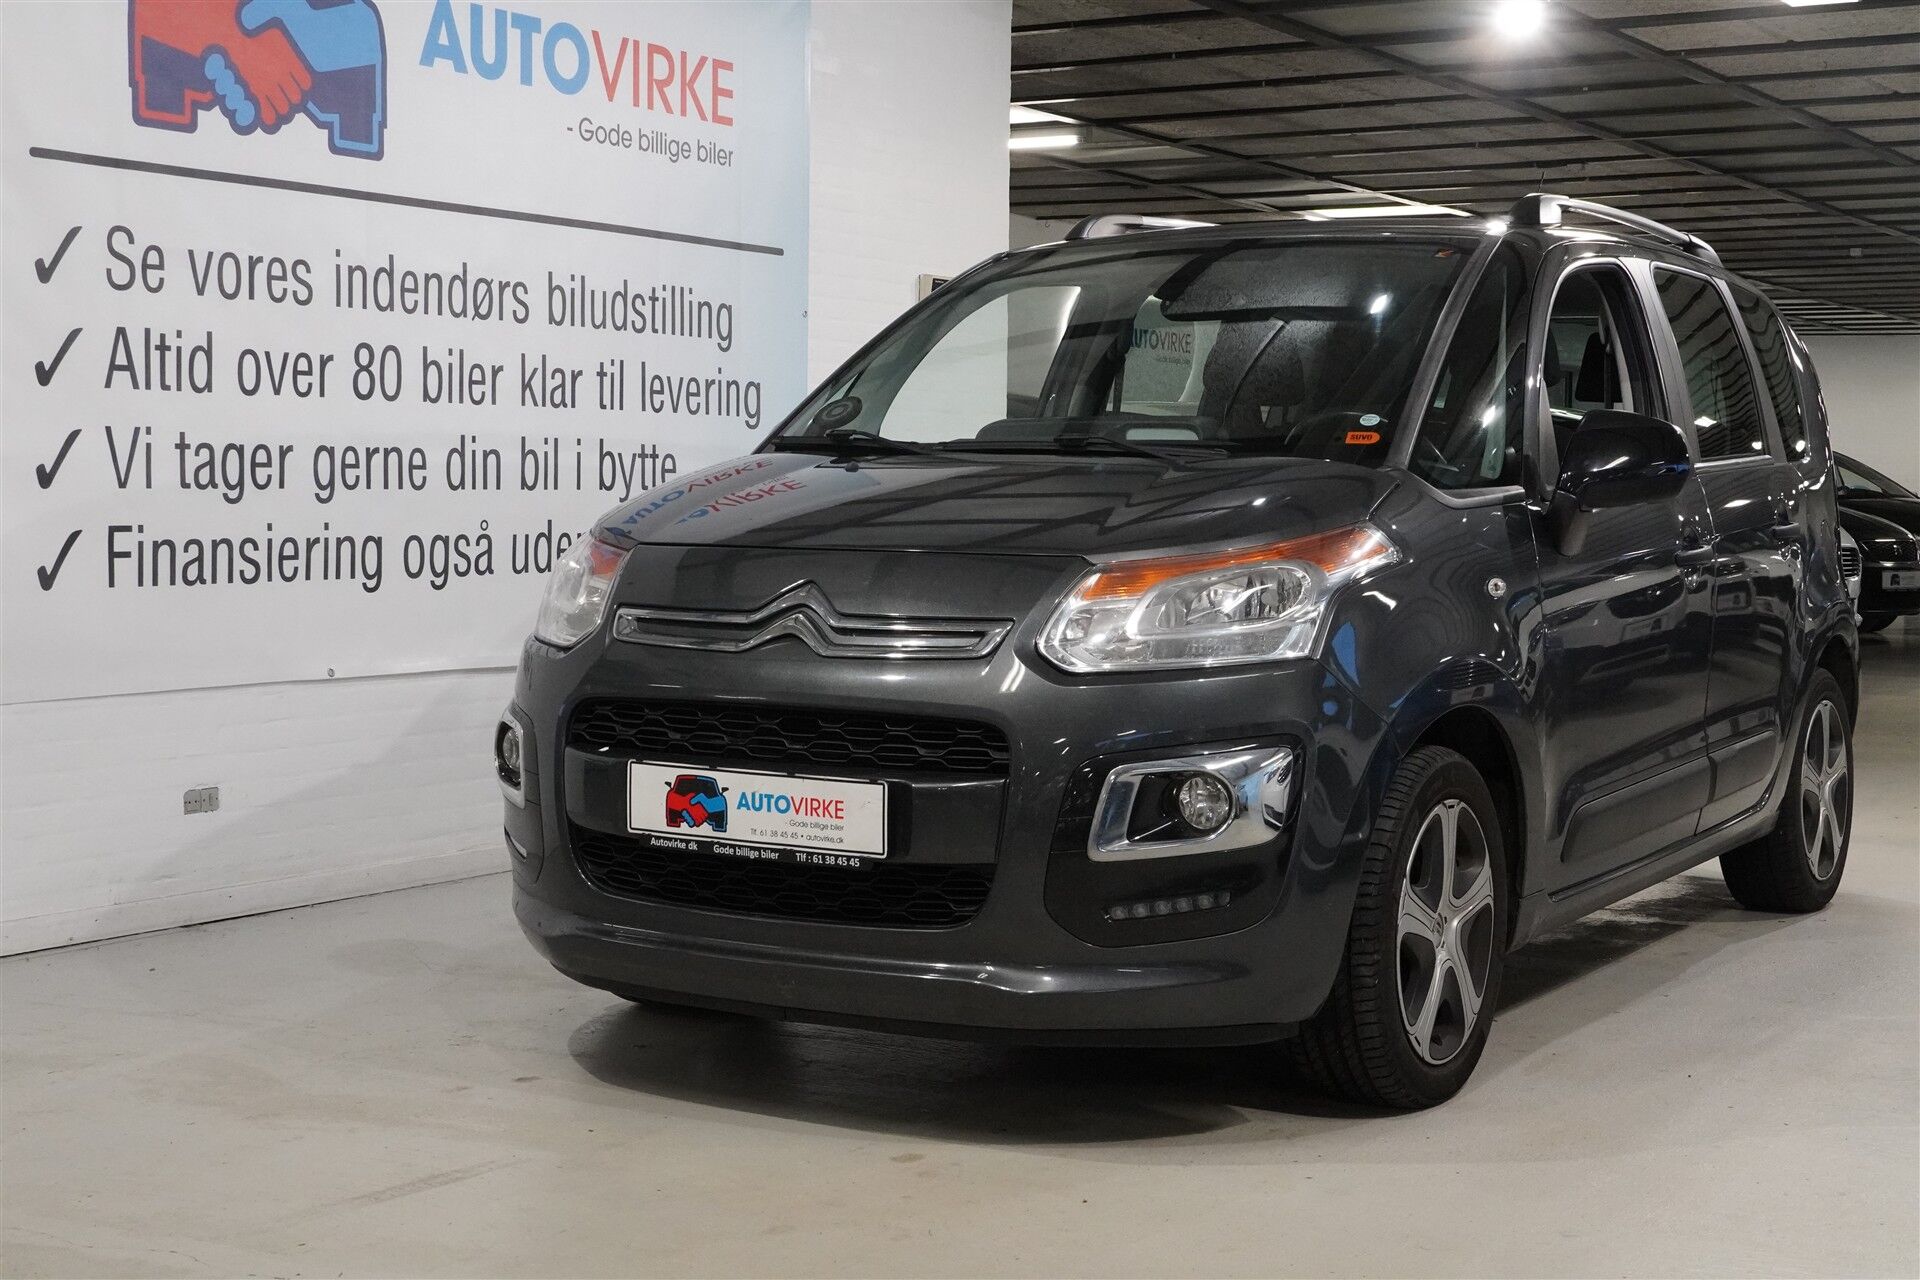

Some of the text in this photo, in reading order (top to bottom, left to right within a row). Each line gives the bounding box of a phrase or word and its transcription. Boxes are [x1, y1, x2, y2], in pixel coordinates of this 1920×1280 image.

[419, 0, 734, 127] AUTOVIRKE
[578, 117, 633, 149] Gode
[638, 128, 692, 164] billige
[697, 139, 734, 167] biler
[106, 225, 733, 353] Se vores indendørs biludstilling
[1130, 328, 1191, 354] UTOVIRKE
[104, 326, 761, 430] Altid over 80 biler klar til levering
[104, 425, 677, 505] Vi tager gerne din bil i bytte
[107, 519, 582, 594] Finansiering også ude
[736, 791, 844, 819] AUTOVIRKE
[789, 820, 808, 828] Gode
[650, 837, 698, 850] Autovirke dk
[713, 845, 780, 860] Gode billige biler
[812, 855, 823, 864] 61
[825, 855, 835, 865] 38
[837, 856, 847, 866] 45
[849, 858, 860, 867] 45
